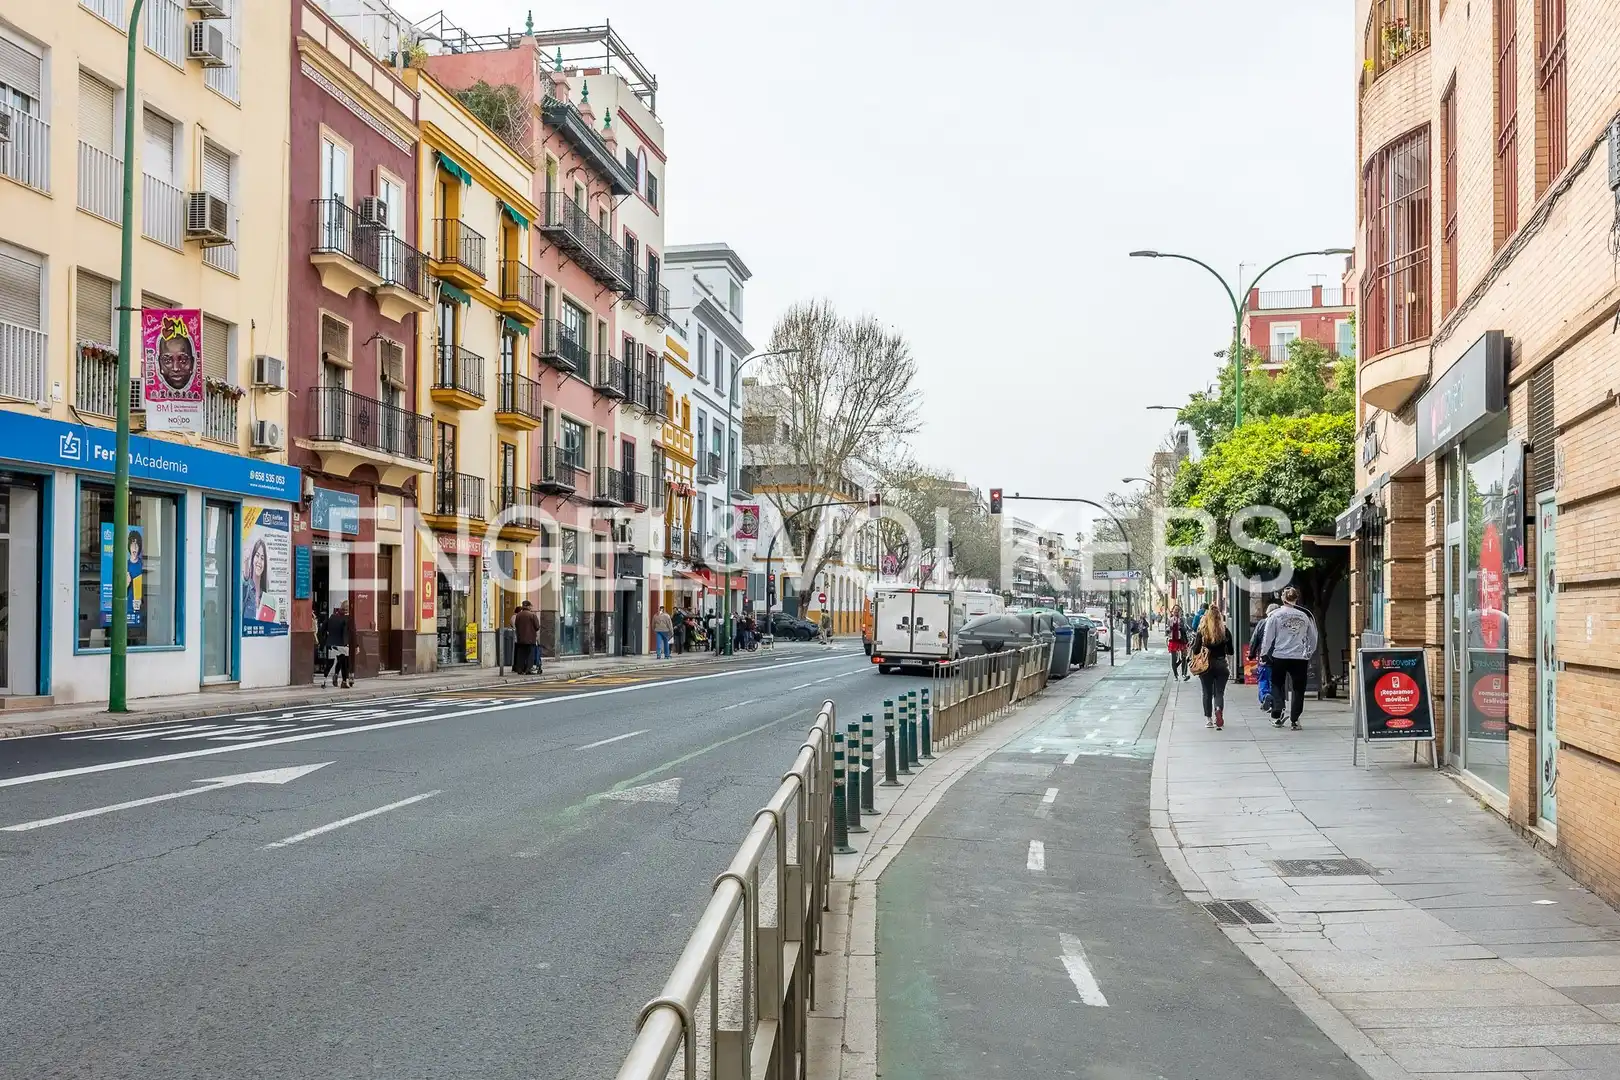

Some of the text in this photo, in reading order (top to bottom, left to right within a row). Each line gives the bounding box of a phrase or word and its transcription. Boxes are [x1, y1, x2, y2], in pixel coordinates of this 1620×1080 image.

[94, 445, 188, 473] Fern Academia
[255, 471, 285, 485] 658 535 053
[438, 537, 457, 549] SUPER
[425, 581, 431, 598] 9
[1381, 657, 1416, 666] funcovers
[235, 708, 437, 721] BUS
[59, 724, 336, 741] TAXI
